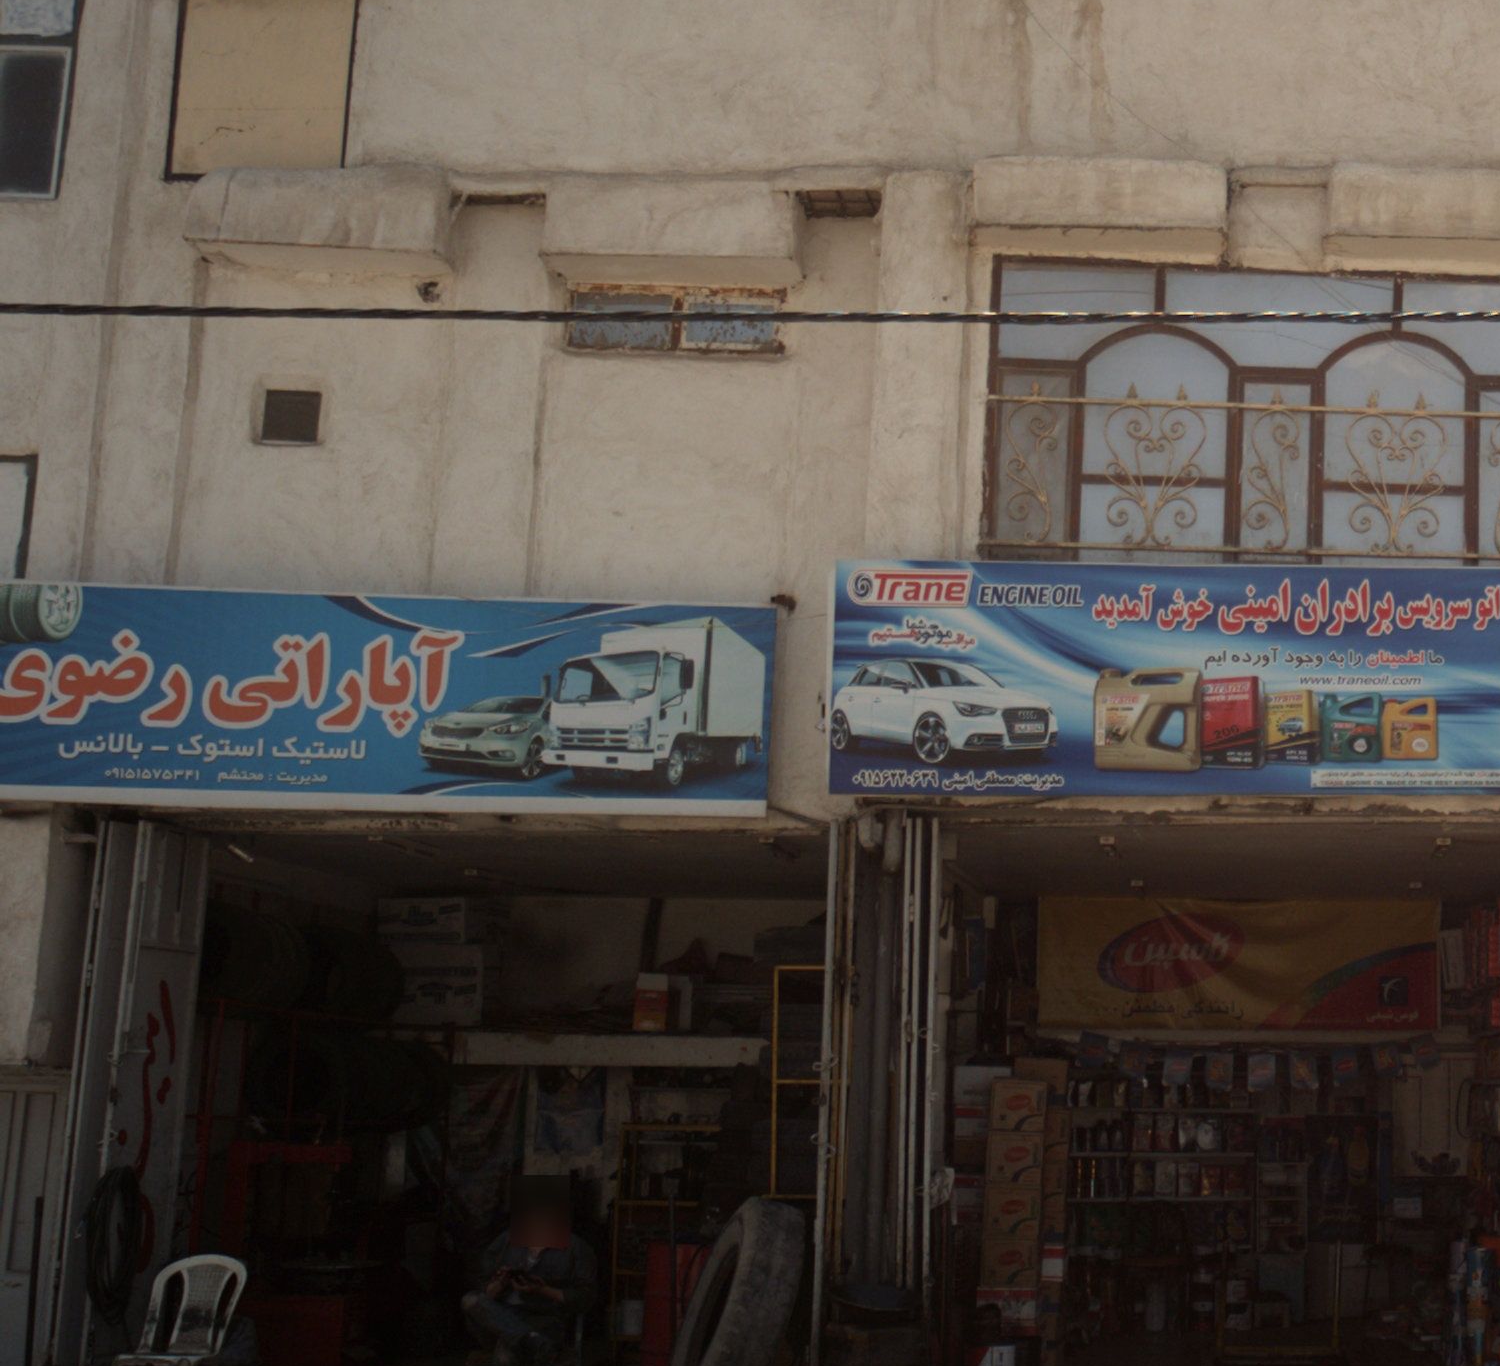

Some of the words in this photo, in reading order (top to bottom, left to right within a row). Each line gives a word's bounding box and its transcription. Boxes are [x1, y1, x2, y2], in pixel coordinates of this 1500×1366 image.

[874, 573, 969, 602] Trane
[978, 585, 1049, 607] ENGINE
[1053, 584, 1084, 607] OIL
[1091, 584, 1156, 626] آمدید
[1156, 588, 1214, 633] خوش
[1218, 579, 1291, 635] امینی
[1294, 578, 1395, 636] برادران
[1397, 593, 1471, 630] سرویس
[1203, 650, 1228, 670] ایم
[1230, 647, 1279, 668] آورده
[1284, 650, 1325, 669] وجود
[1365, 650, 1425, 668] اطمینان
[0, 628, 193, 730] رضوی
[200, 627, 465, 739] آپاراتی
[1299, 673, 1421, 687] www.traneoil.com
[57, 732, 144, 761] بالانس
[176, 737, 264, 765] استوک
[271, 738, 366, 767] لاستیک
[216, 767, 264, 784] محتشم
[276, 768, 328, 787] مدیریت
[942, 769, 975, 792] امینی
